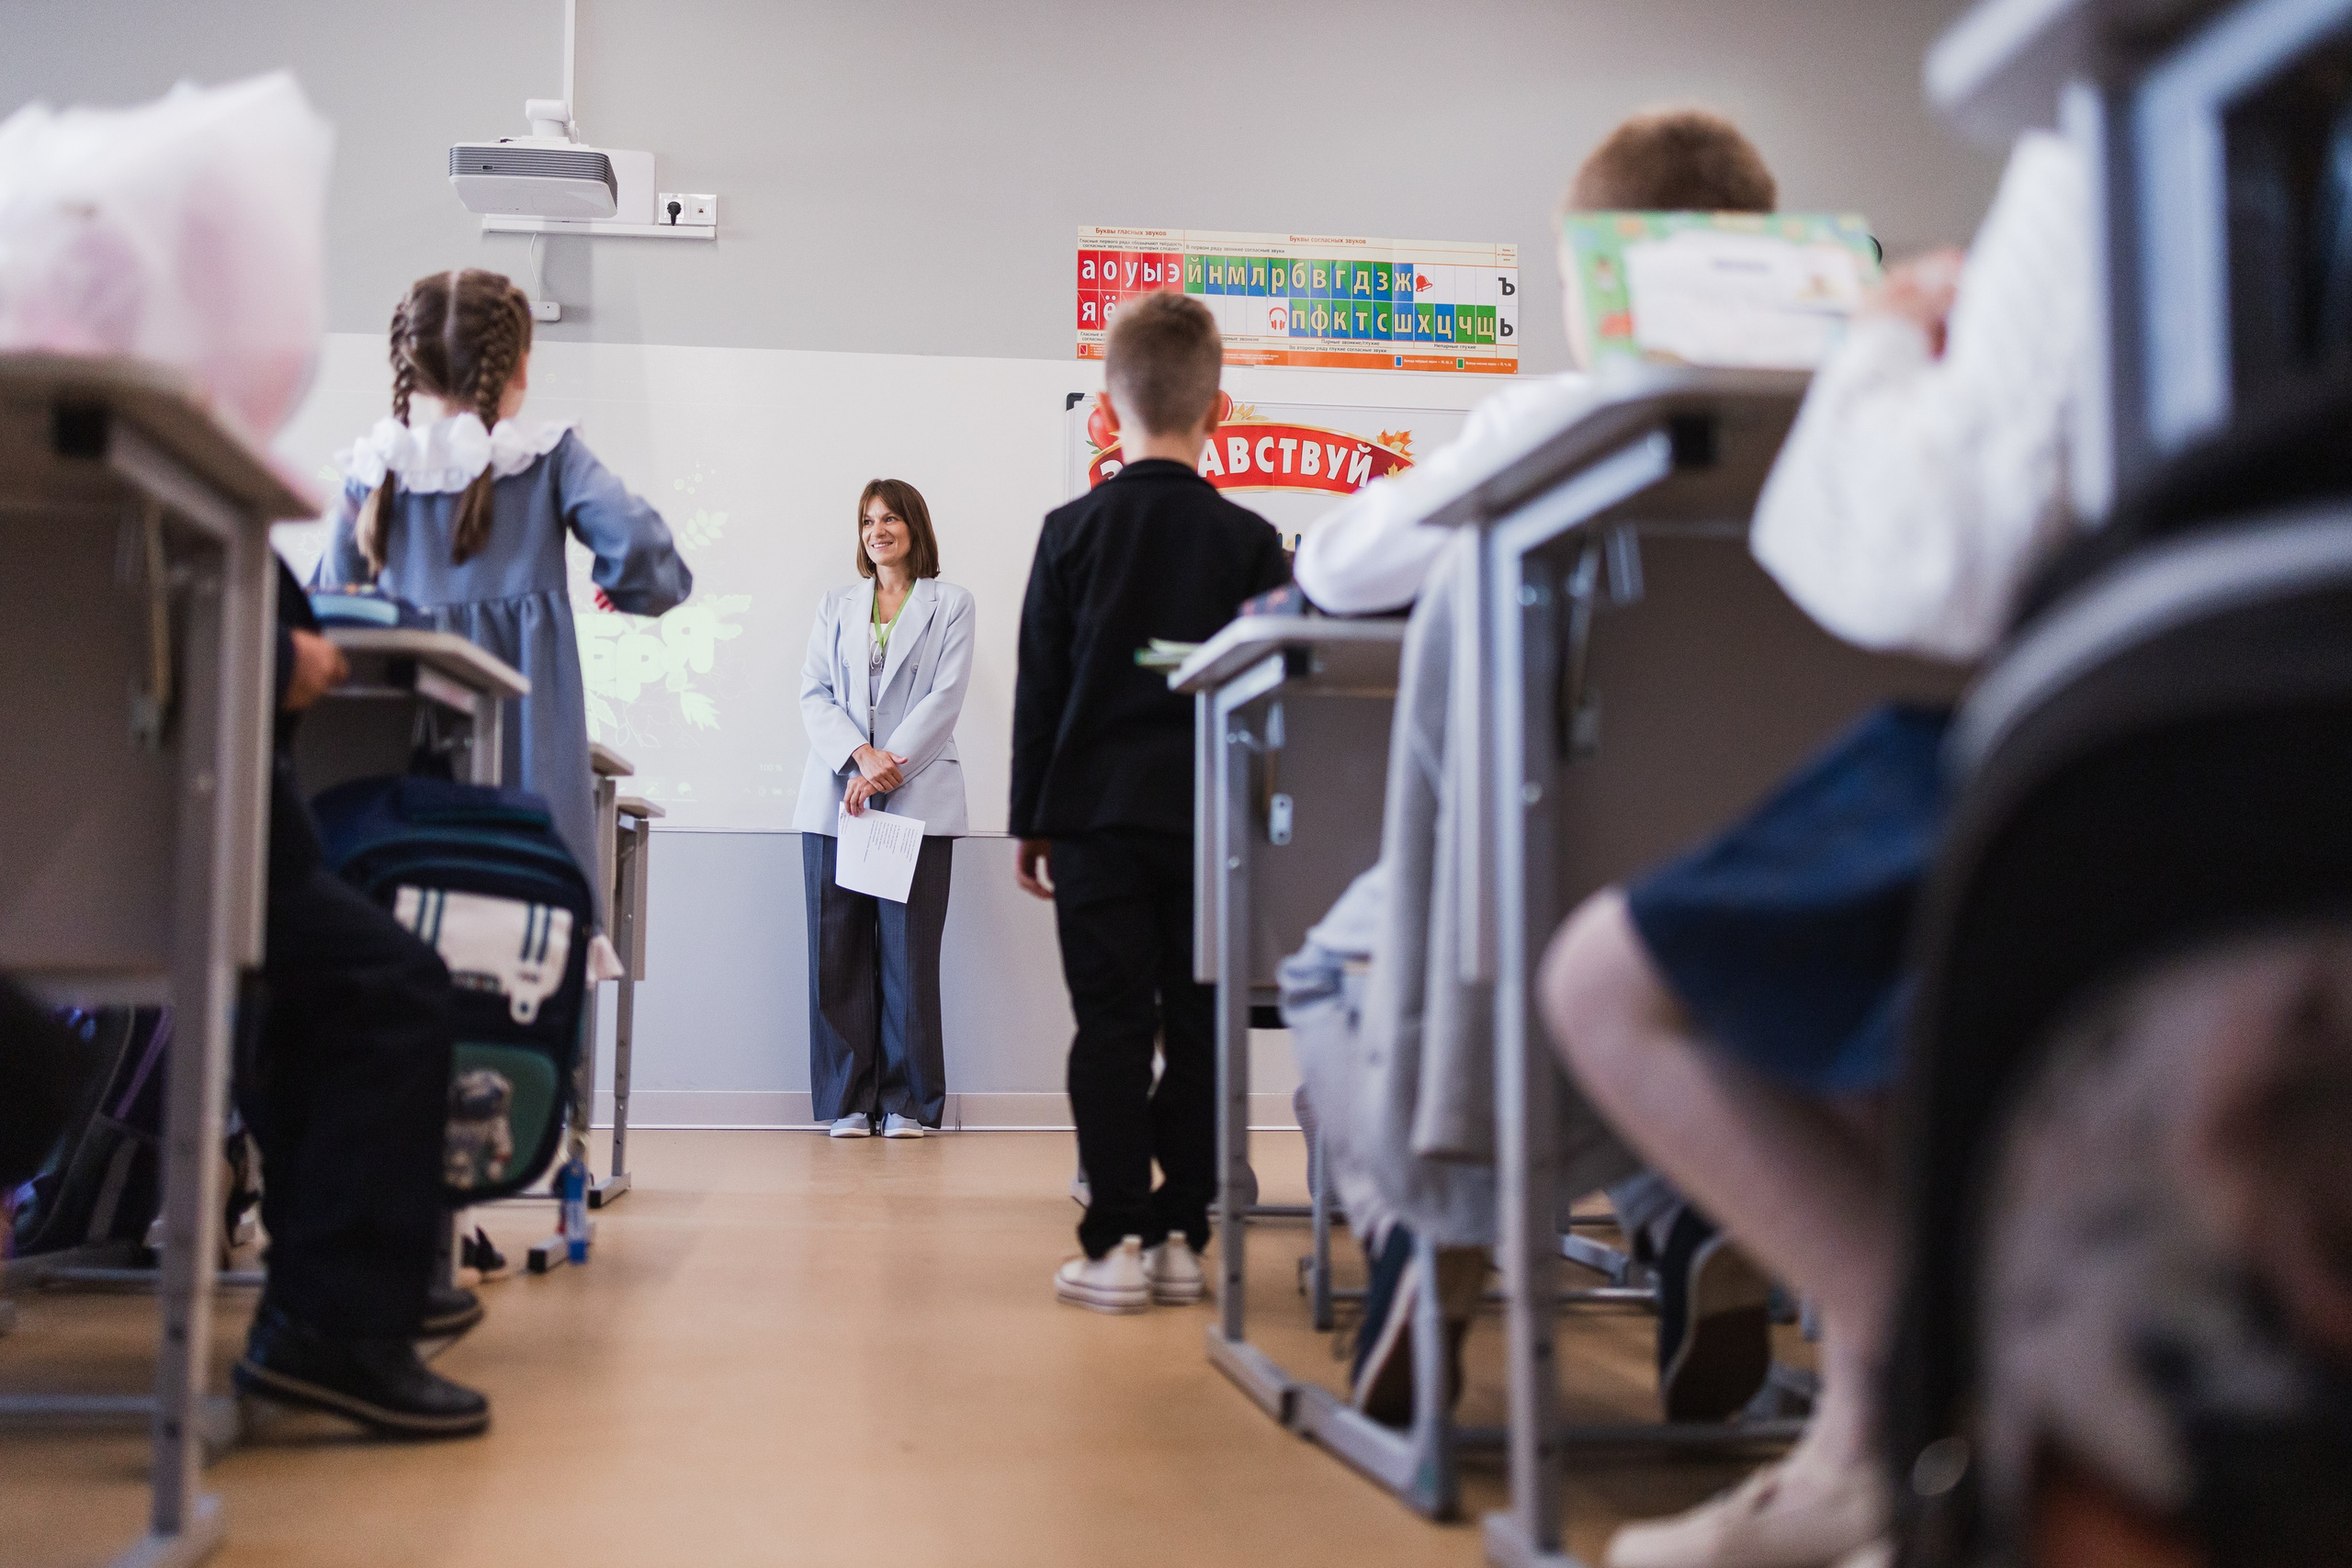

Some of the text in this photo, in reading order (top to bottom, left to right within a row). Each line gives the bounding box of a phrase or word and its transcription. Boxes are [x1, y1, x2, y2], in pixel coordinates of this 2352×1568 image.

[1081, 257, 1516, 296] а о у ы э й н м л р б в г д з ж ъ
[1081, 301, 1096, 321] я
[1292, 310, 1306, 329] п
[1310, 303, 1329, 337] ф
[1334, 310, 1347, 331] к
[1355, 312, 1368, 331] т
[1376, 312, 1388, 333] с
[1394, 313, 1412, 333] ш
[1417, 314, 1431, 333] х
[1437, 314, 1453, 340] ц
[1458, 316, 1472, 335] ч
[1476, 316, 1495, 341] щ
[1499, 318, 1514, 336] ь
